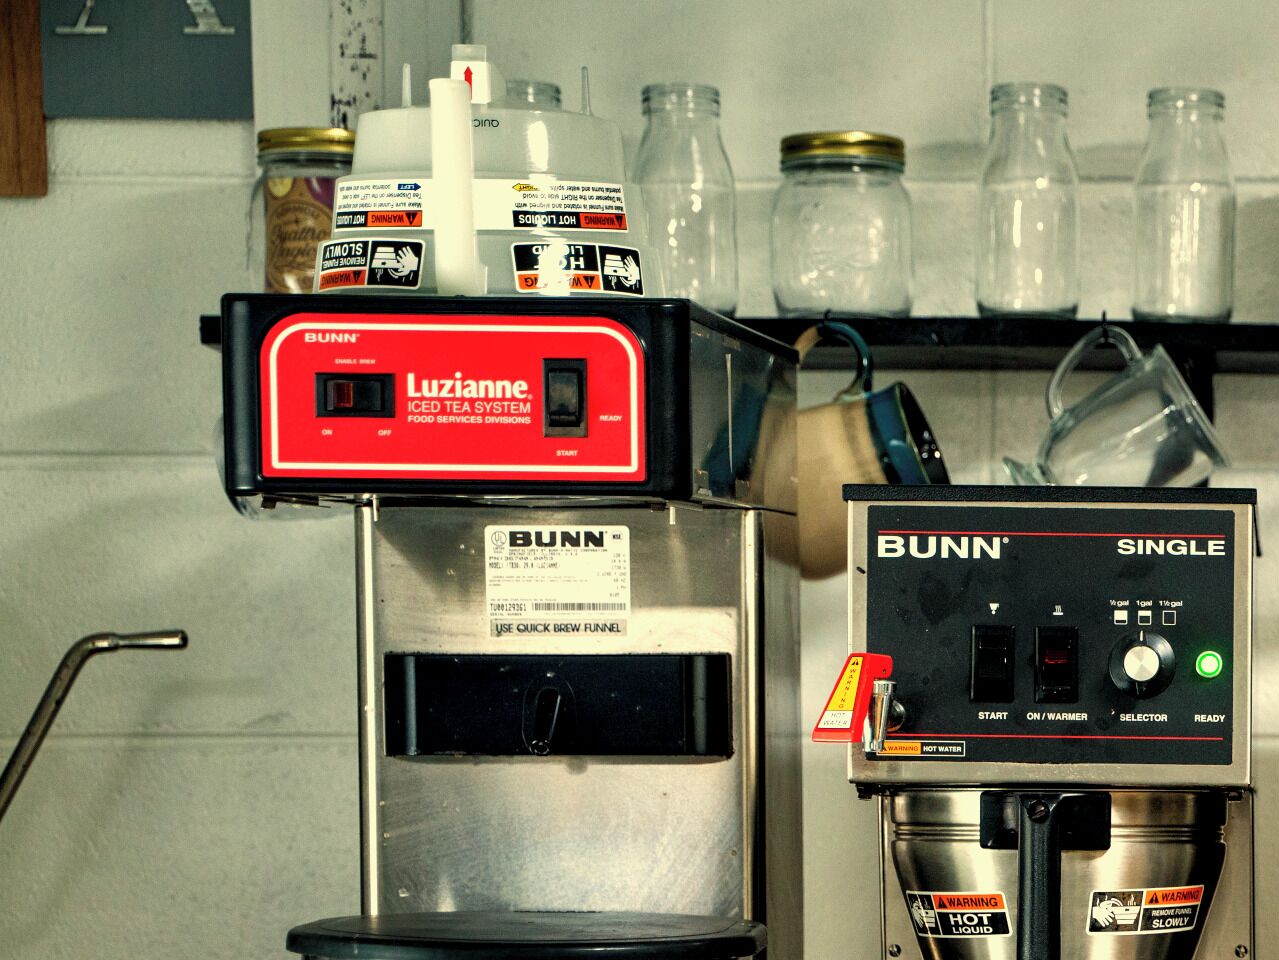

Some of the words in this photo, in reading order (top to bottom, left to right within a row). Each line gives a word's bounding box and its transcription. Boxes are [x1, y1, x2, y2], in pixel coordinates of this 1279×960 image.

[474, 119, 499, 128] QUIC
[352, 215, 365, 224] HOT
[371, 214, 404, 223] WARNING
[519, 215, 556, 224] LIQUIDS
[559, 215, 576, 224] HOT
[584, 216, 615, 225] WARNING
[325, 243, 363, 258] SLOWLY
[339, 257, 365, 267] REMOVE
[322, 273, 351, 284] WARNING
[305, 333, 357, 343] BUNN
[407, 371, 529, 399] Luzianne
[407, 401, 441, 413] ICED
[446, 402, 472, 413] TEA
[474, 402, 531, 414] SYSTEM
[407, 415, 435, 423] FOOD
[436, 415, 484, 424] SERVICES
[485, 415, 531, 424] DIVISIONS
[509, 531, 604, 547] BUNN
[877, 536, 1000, 559] BUNN
[1117, 539, 1226, 556] SINGLE
[496, 623, 514, 633] USE
[517, 623, 550, 633] QUICK
[554, 623, 581, 633] BREW
[584, 623, 621, 633] FUNNEL
[838, 668, 856, 709] WARNING
[978, 711, 1008, 721] START
[1119, 713, 1168, 722] SELECTOR
[1194, 714, 1225, 723] READY
[1161, 889, 1201, 902] WARNING
[947, 897, 998, 909] WARNING
[1151, 909, 1175, 918] REMOVE
[1176, 908, 1193, 916] FUNNEL
[950, 913, 992, 927] HOT
[1151, 916, 1190, 929] SLOWLY
[952, 926, 993, 935] LIQUID
